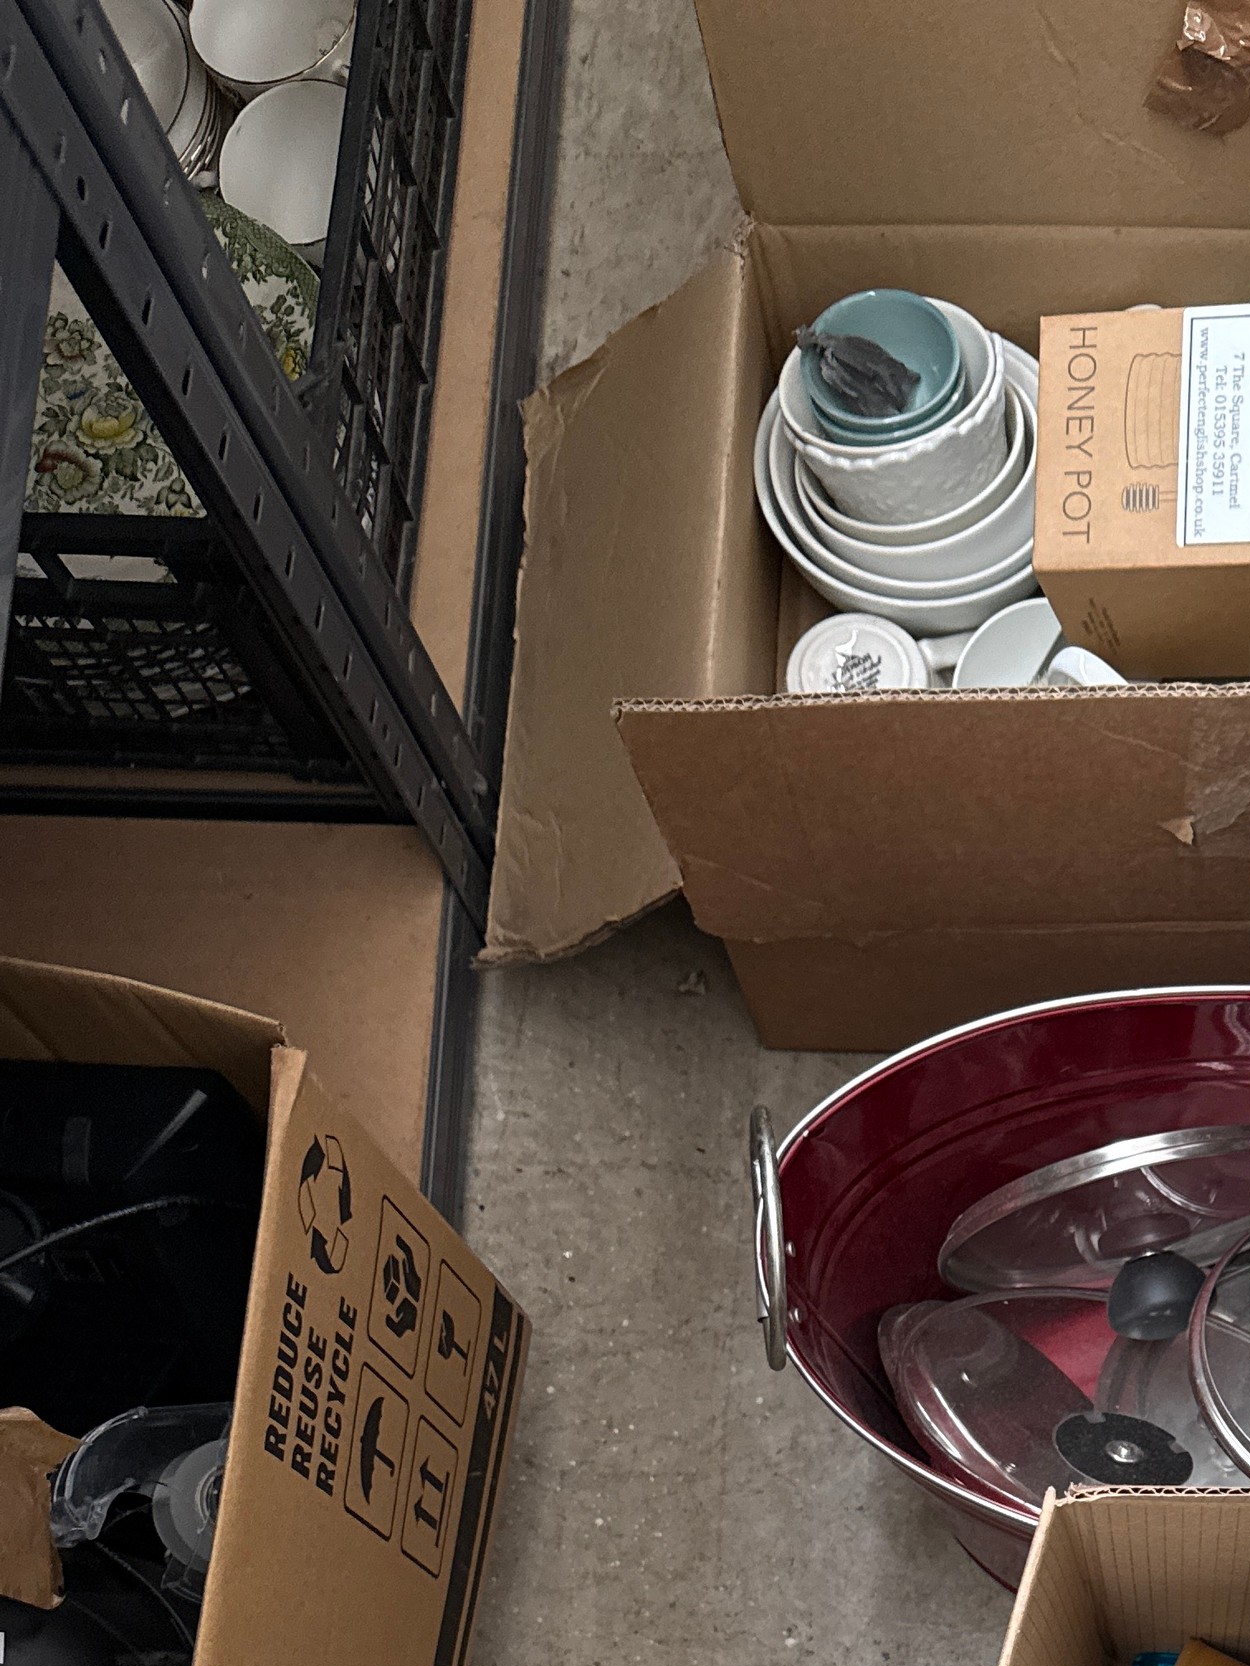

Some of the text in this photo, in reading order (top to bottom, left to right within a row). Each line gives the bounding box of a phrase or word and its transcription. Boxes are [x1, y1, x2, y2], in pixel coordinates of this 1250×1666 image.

[1061, 325, 1098, 545] HONEY POT
[1192, 327, 1211, 538] www.perfectenglishshop.co.uk
[1211, 452, 1226, 496] 35911
[1213, 394, 1227, 448] 015395
[1228, 351, 1245, 510] 7 The Square, Cartmel
[265, 1272, 308, 1462] REDUCE
[291, 1326, 328, 1480] REUSE
[315, 1296, 358, 1497] RECYCLE
